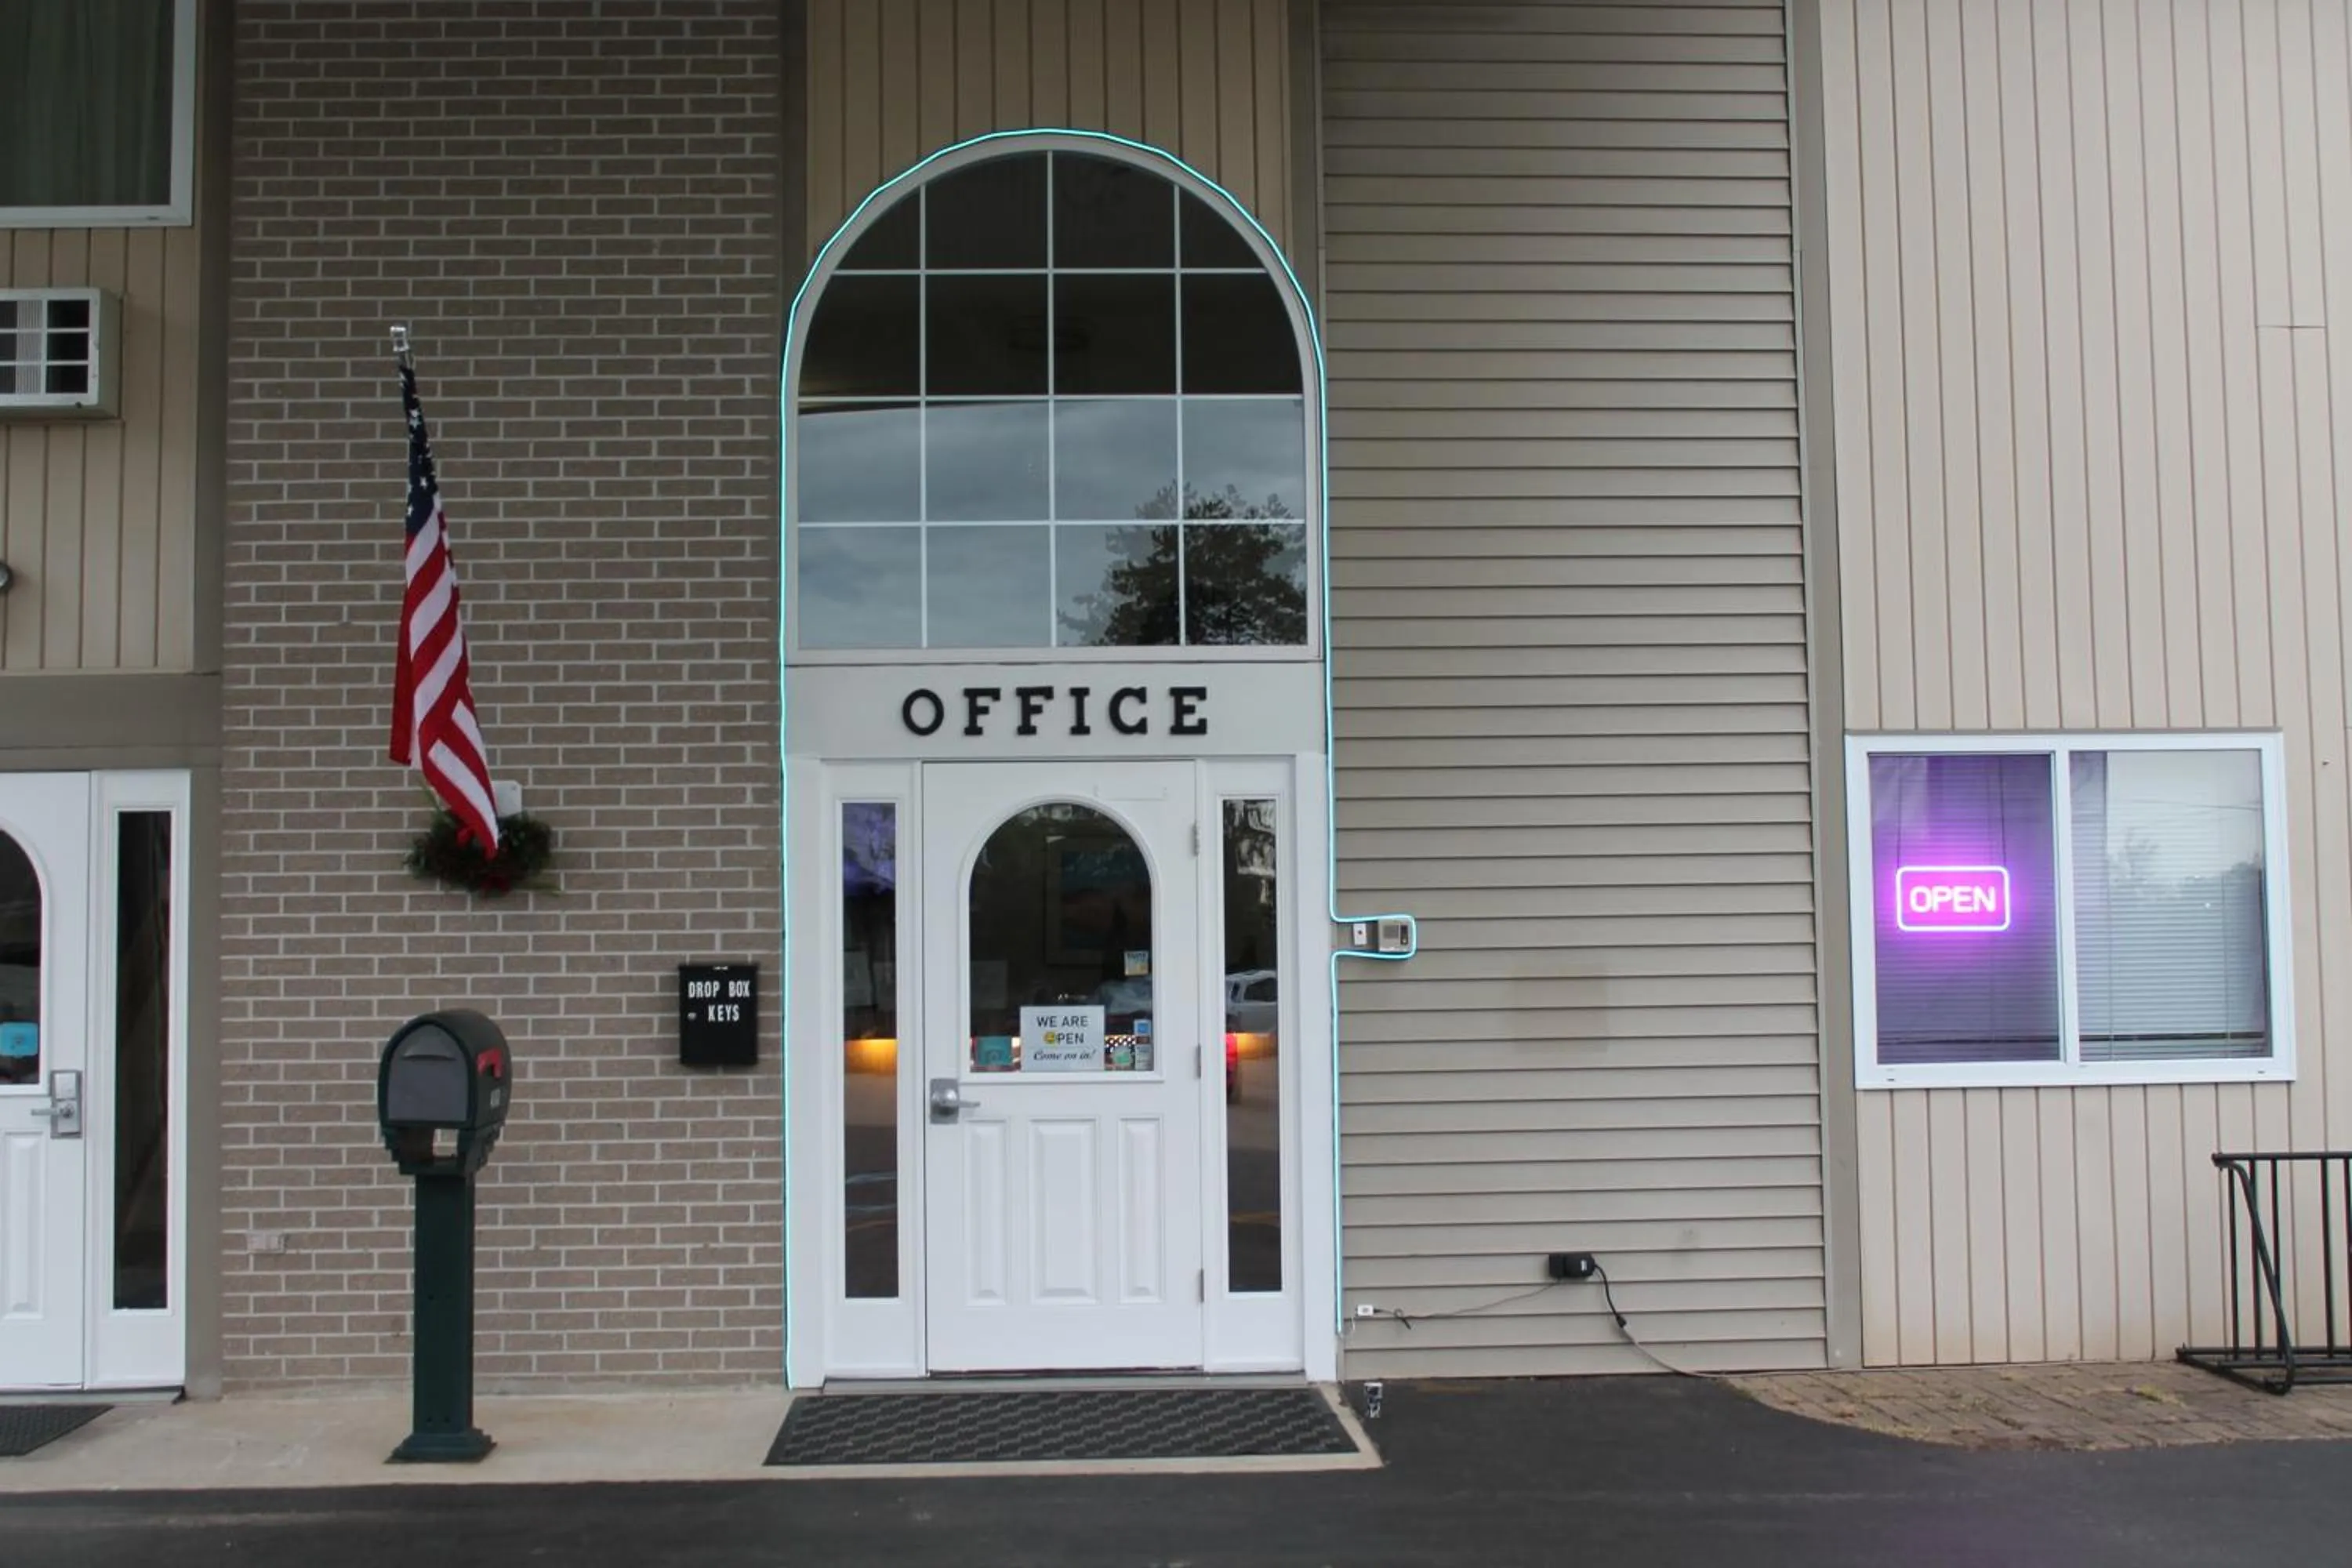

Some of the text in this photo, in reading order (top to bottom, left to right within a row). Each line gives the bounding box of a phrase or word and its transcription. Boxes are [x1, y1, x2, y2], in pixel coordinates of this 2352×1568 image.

[902, 686, 1207, 736] OFFICE
[1910, 885, 1996, 913] OPEN
[688, 981, 750, 998] DROP BOX
[708, 1004, 739, 1022] KEYS
[1036, 1015, 1088, 1027] WE ARE
